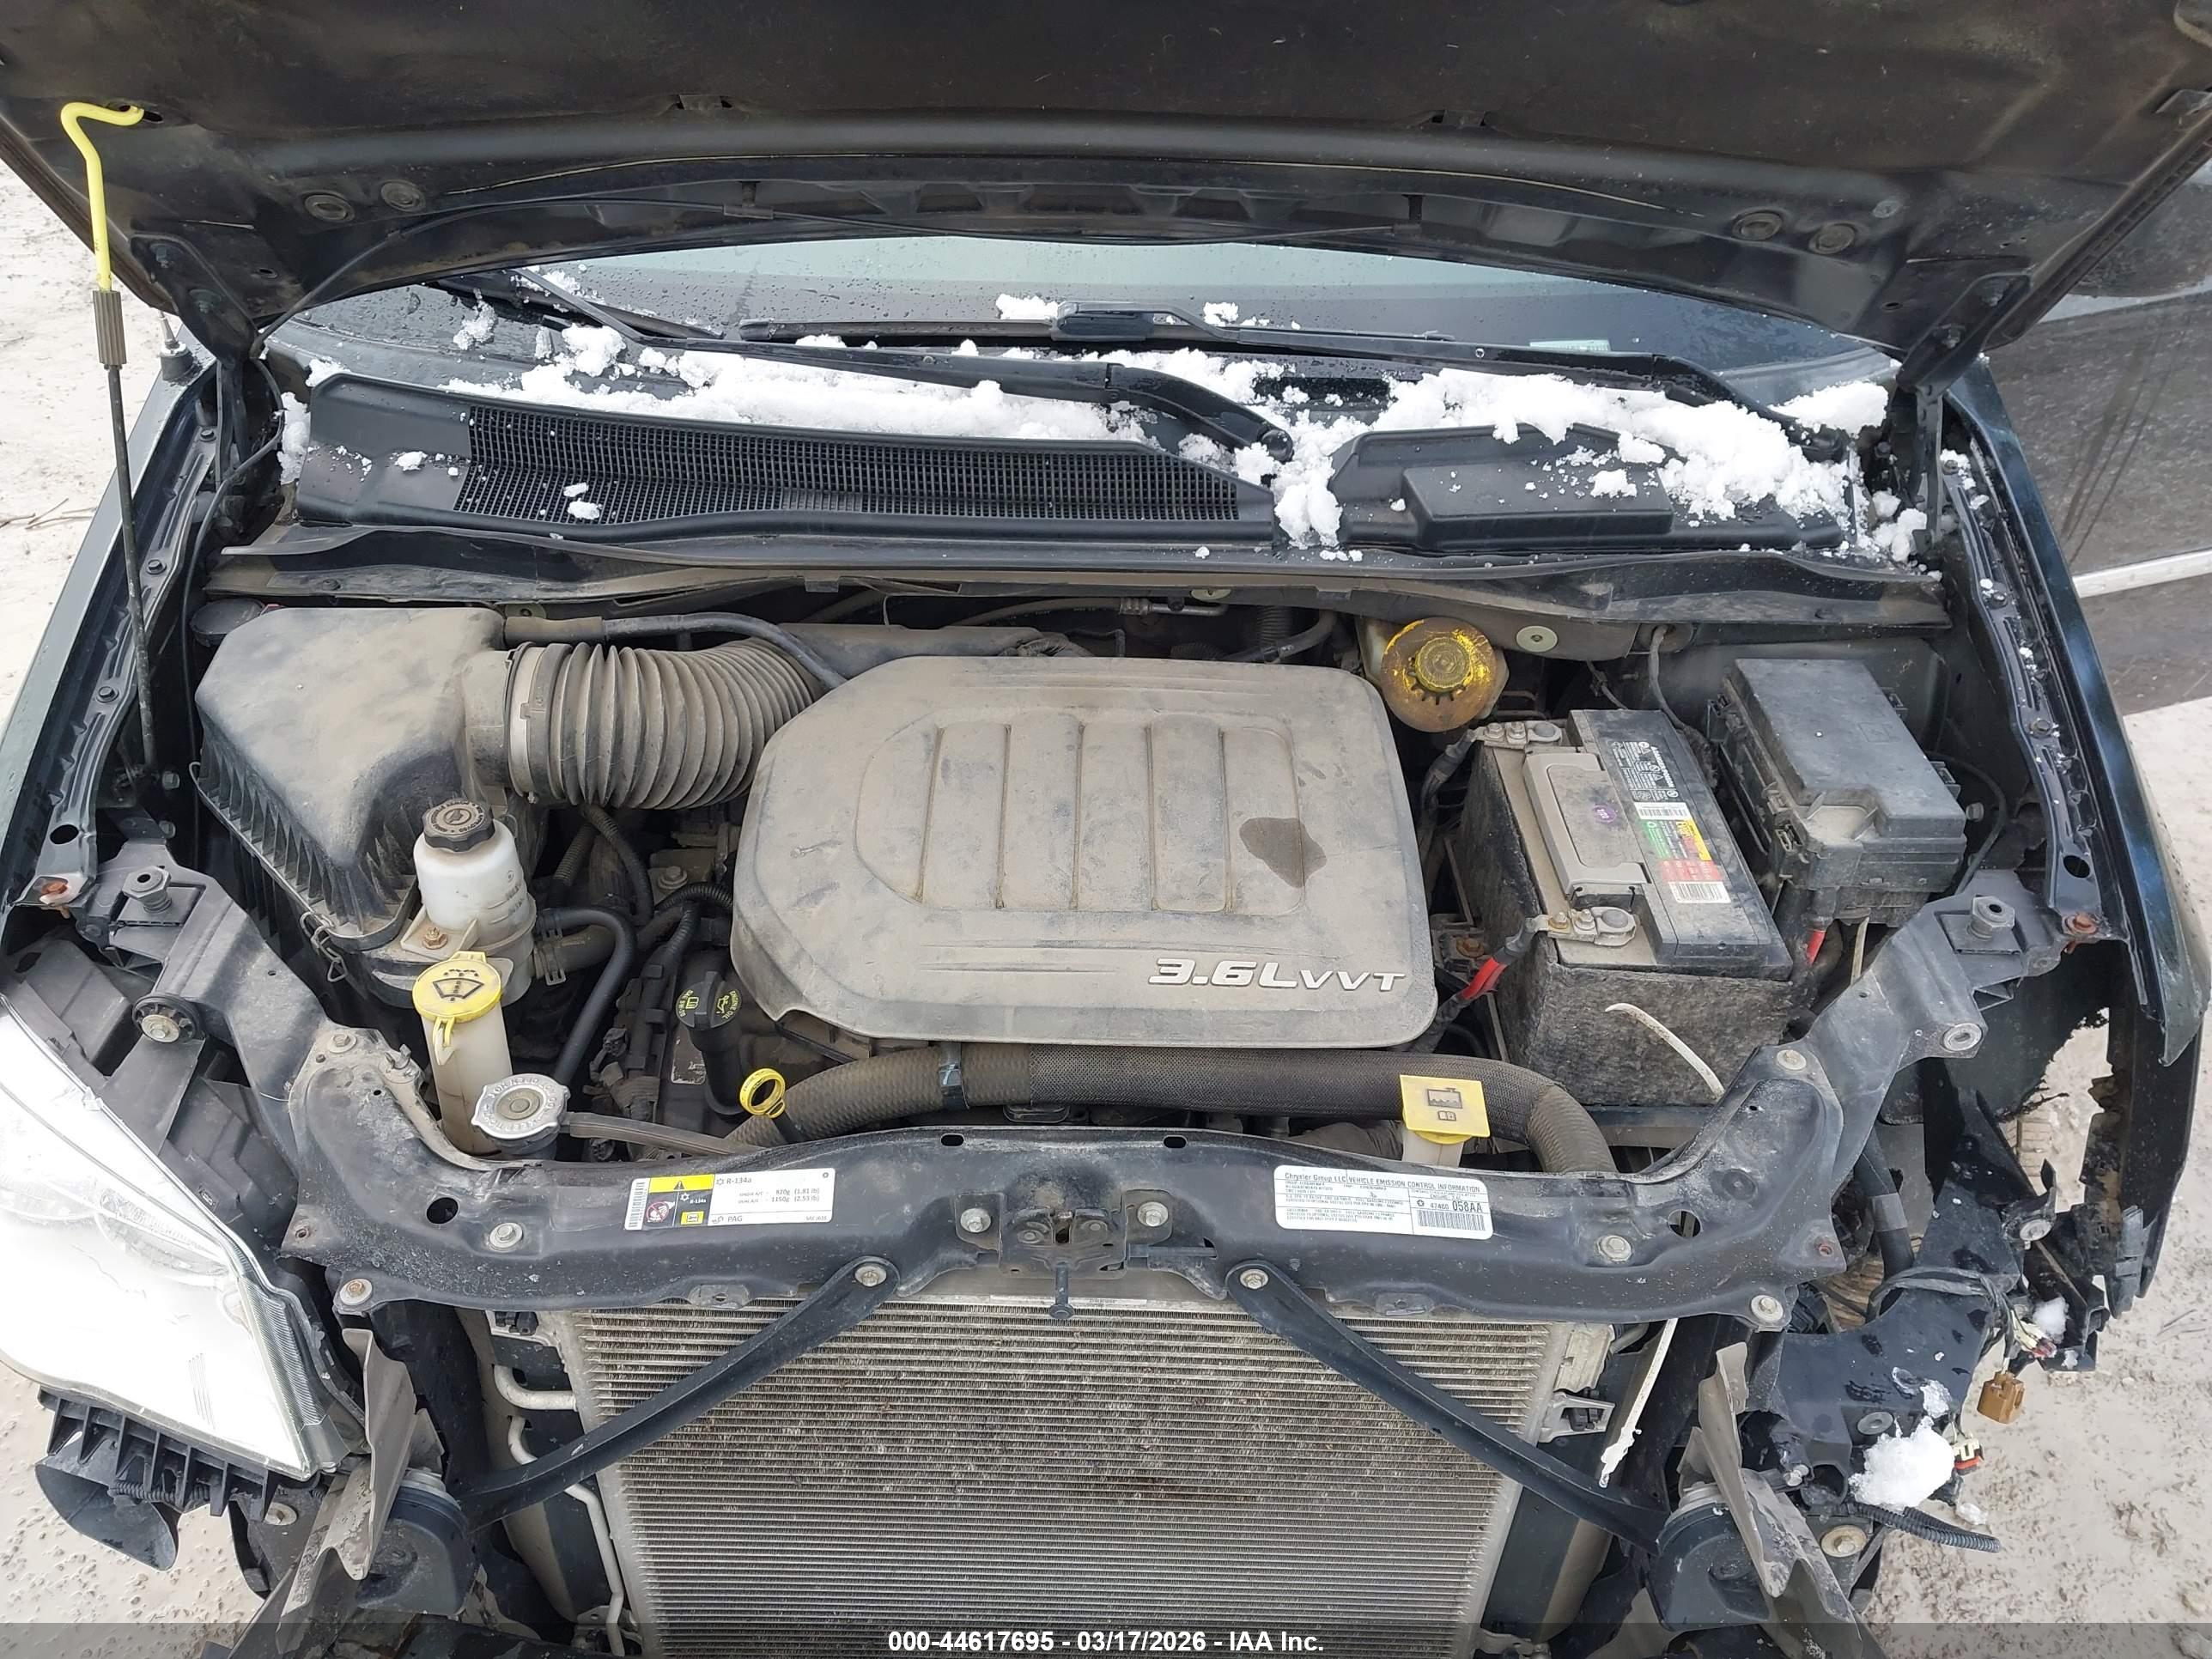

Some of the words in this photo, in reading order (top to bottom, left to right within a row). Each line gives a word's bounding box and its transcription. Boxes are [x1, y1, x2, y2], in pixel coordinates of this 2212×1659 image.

[729, 990, 738, 1011] ENGINE
[721, 1011, 734, 1019] OIL
[1285, 1172, 1311, 1181] Chrysler
[1376, 1178, 1406, 1187] EMISSION
[1407, 1181, 1436, 1189] CONTROL
[1437, 1183, 1480, 1193] INFORMATION
[1452, 1200, 1483, 1212] 058AA
